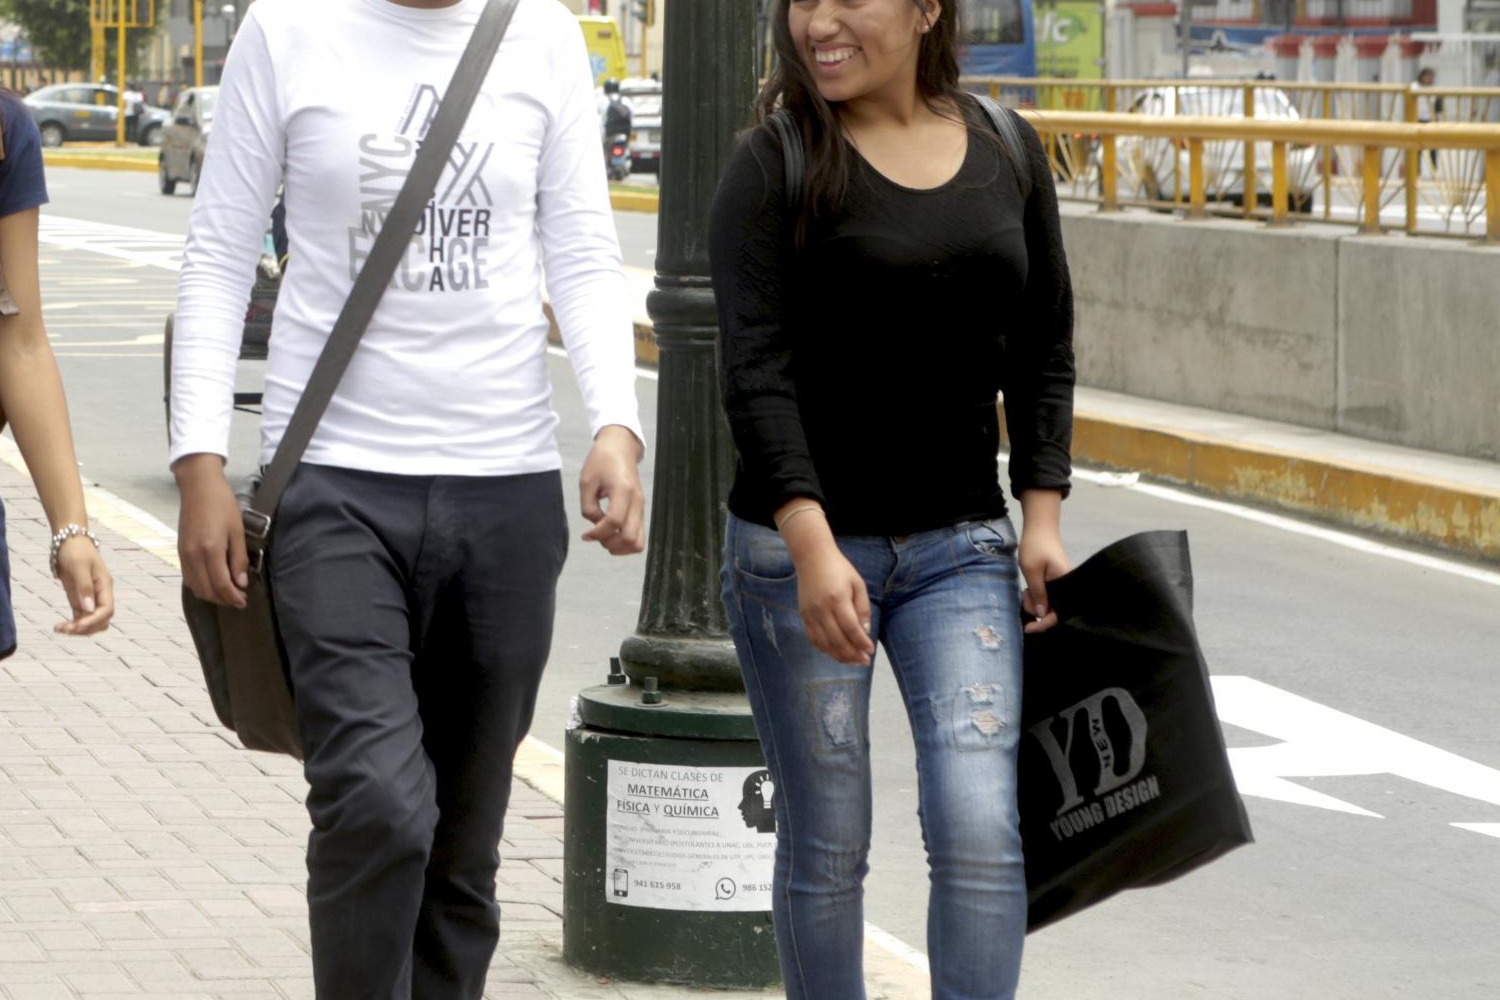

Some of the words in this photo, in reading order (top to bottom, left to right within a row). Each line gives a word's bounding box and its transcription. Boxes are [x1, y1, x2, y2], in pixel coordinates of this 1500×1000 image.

[618, 766, 629, 776] SE
[631, 767, 668, 780] DICTAN
[670, 770, 708, 783] CLASES
[710, 773, 724, 783] DE
[627, 783, 709, 799] MATEMÁTICA
[653, 803, 660, 814] Y
[663, 803, 720, 818] QUÍMICA
[1049, 801, 1105, 841] YOUNG
[1103, 774, 1162, 819] DESIGN
[634, 879, 648, 888] 941
[650, 881, 664, 889] 615
[759, 884, 773, 892] 152
